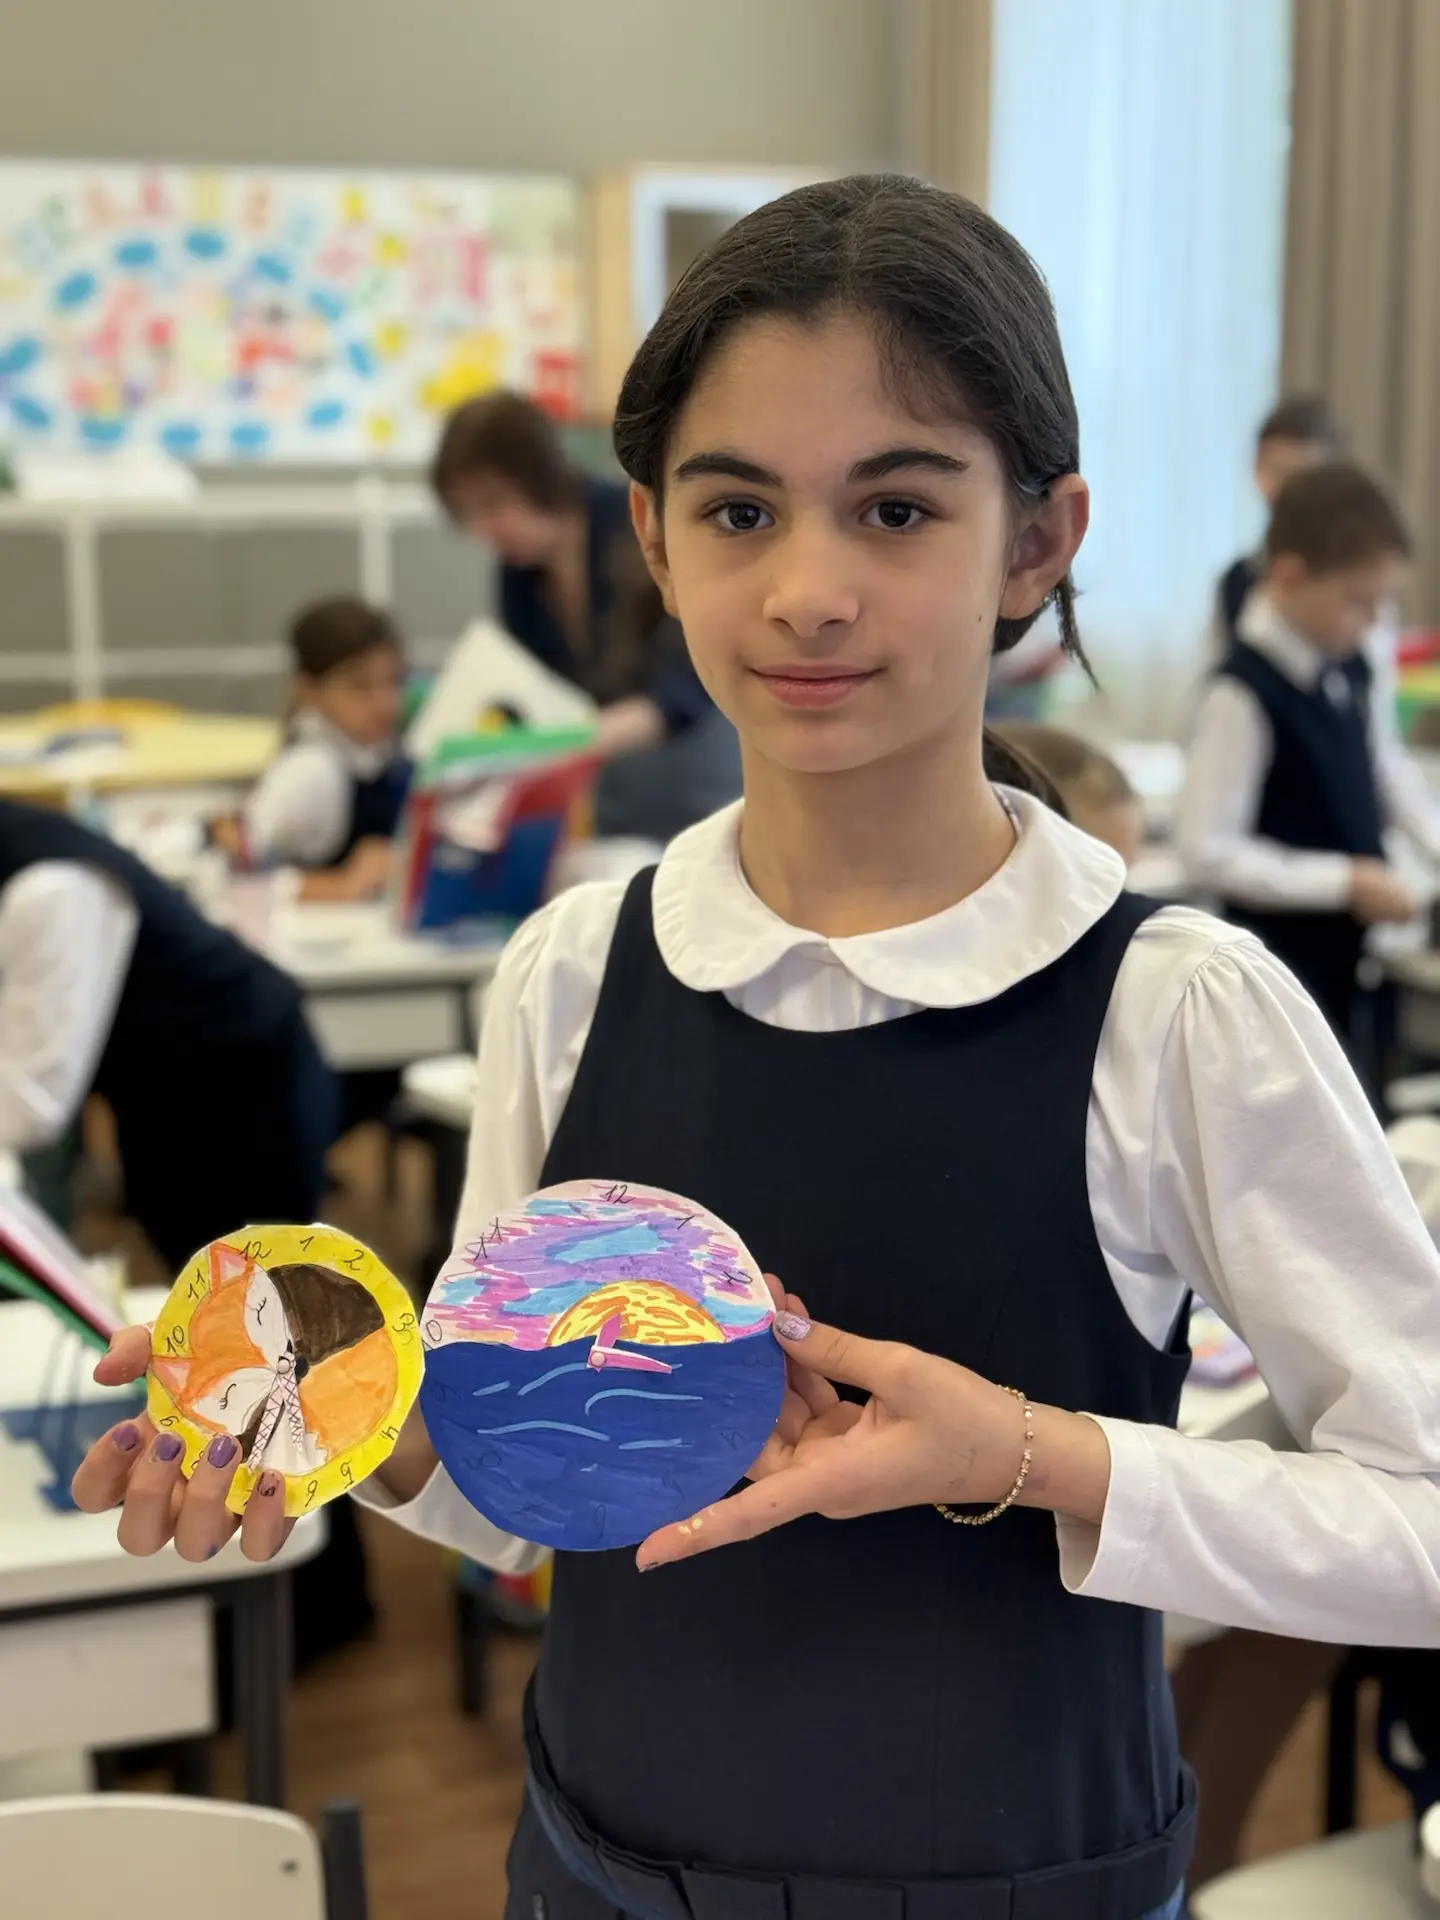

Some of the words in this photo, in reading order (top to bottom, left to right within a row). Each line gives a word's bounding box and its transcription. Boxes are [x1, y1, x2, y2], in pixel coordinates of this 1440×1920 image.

[604, 1184, 636, 1204] 12
[674, 1214, 696, 1230] 1
[240, 1241, 272, 1261] 12
[300, 1236, 315, 1251] 1
[343, 1249, 365, 1271] 2
[187, 1268, 206, 1300] 11
[392, 1312, 415, 1333] 3
[166, 1325, 185, 1353] 10
